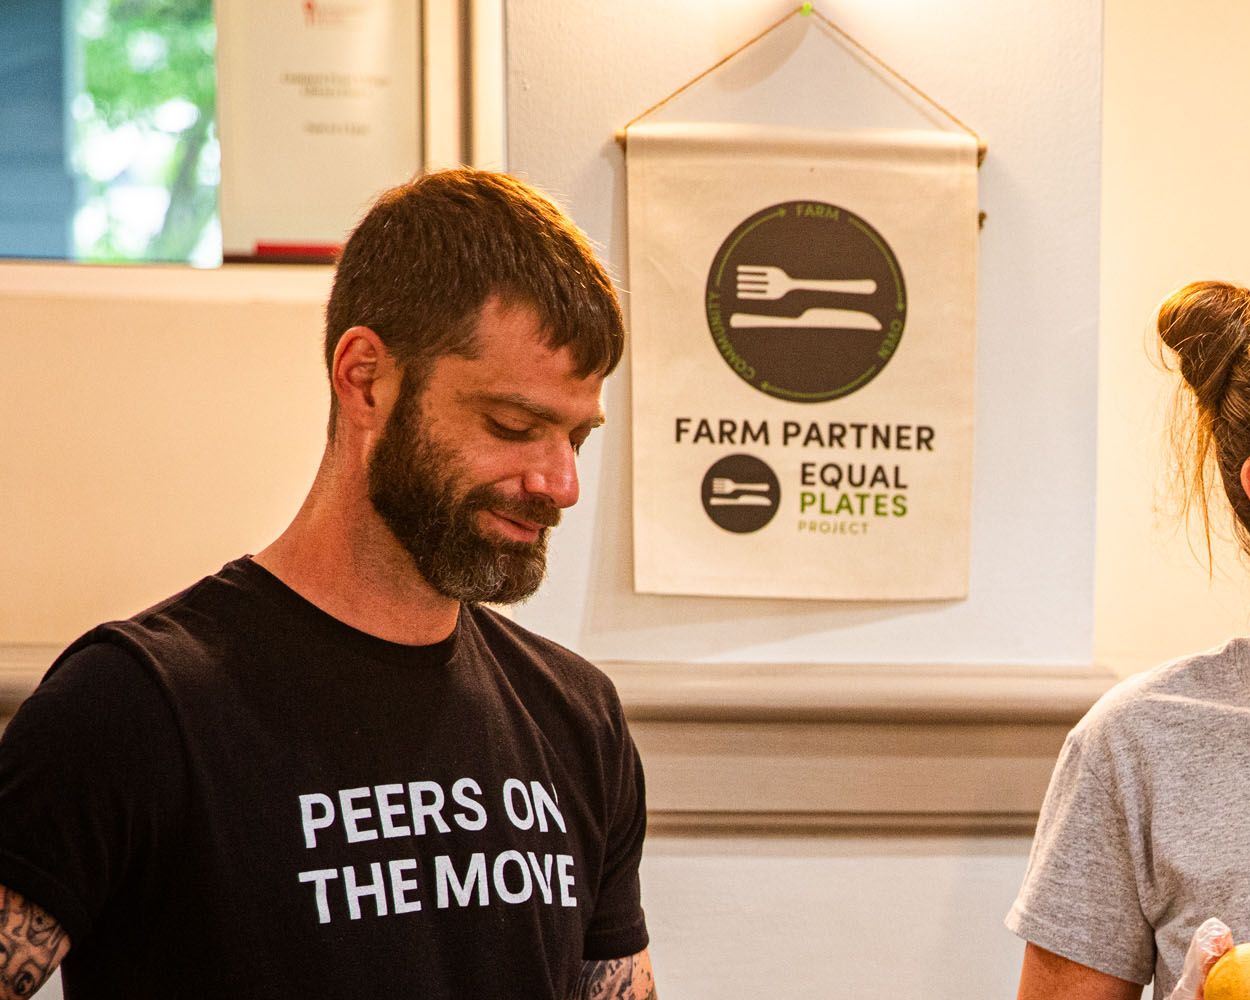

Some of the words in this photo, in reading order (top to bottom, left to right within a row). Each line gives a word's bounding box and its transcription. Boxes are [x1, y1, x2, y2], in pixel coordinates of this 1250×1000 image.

[795, 203, 840, 221] FARM
[708, 291, 756, 380] COMMUNITY
[675, 417, 770, 446] FARM
[783, 421, 935, 451] PARTNER
[800, 462, 908, 490] EQUAL
[799, 492, 908, 518] PLATES
[798, 520, 869, 535] PROJECT
[298, 777, 488, 849] PEERS
[503, 778, 567, 833] ON
[298, 858, 422, 924] THE
[435, 849, 578, 909] MOVE
